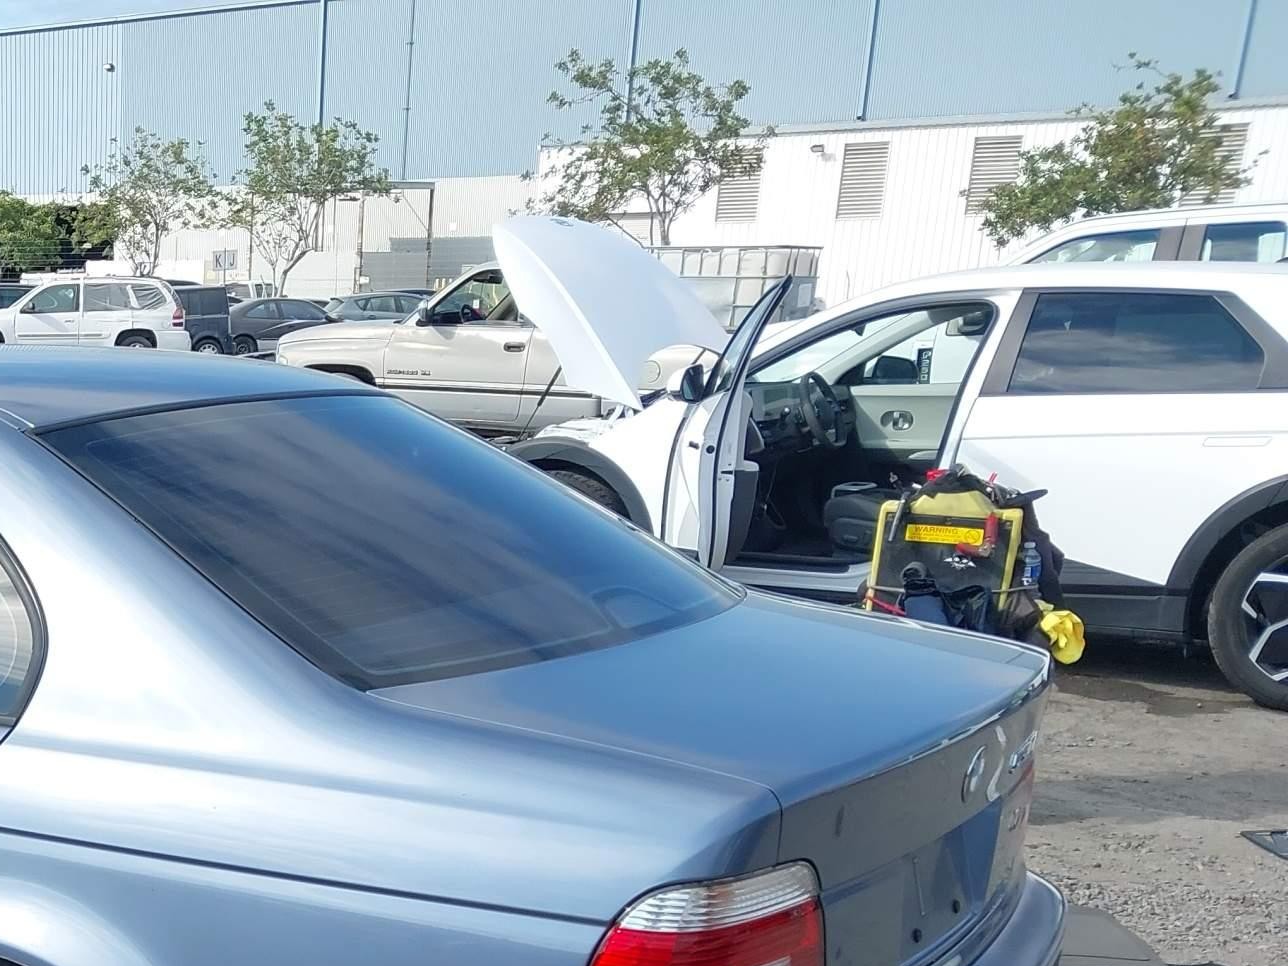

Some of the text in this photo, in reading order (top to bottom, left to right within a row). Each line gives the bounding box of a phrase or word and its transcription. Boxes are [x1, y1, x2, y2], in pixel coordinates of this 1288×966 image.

[215, 254, 223, 268] K
[229, 252, 235, 267] J
[914, 526, 959, 535] WARNING
